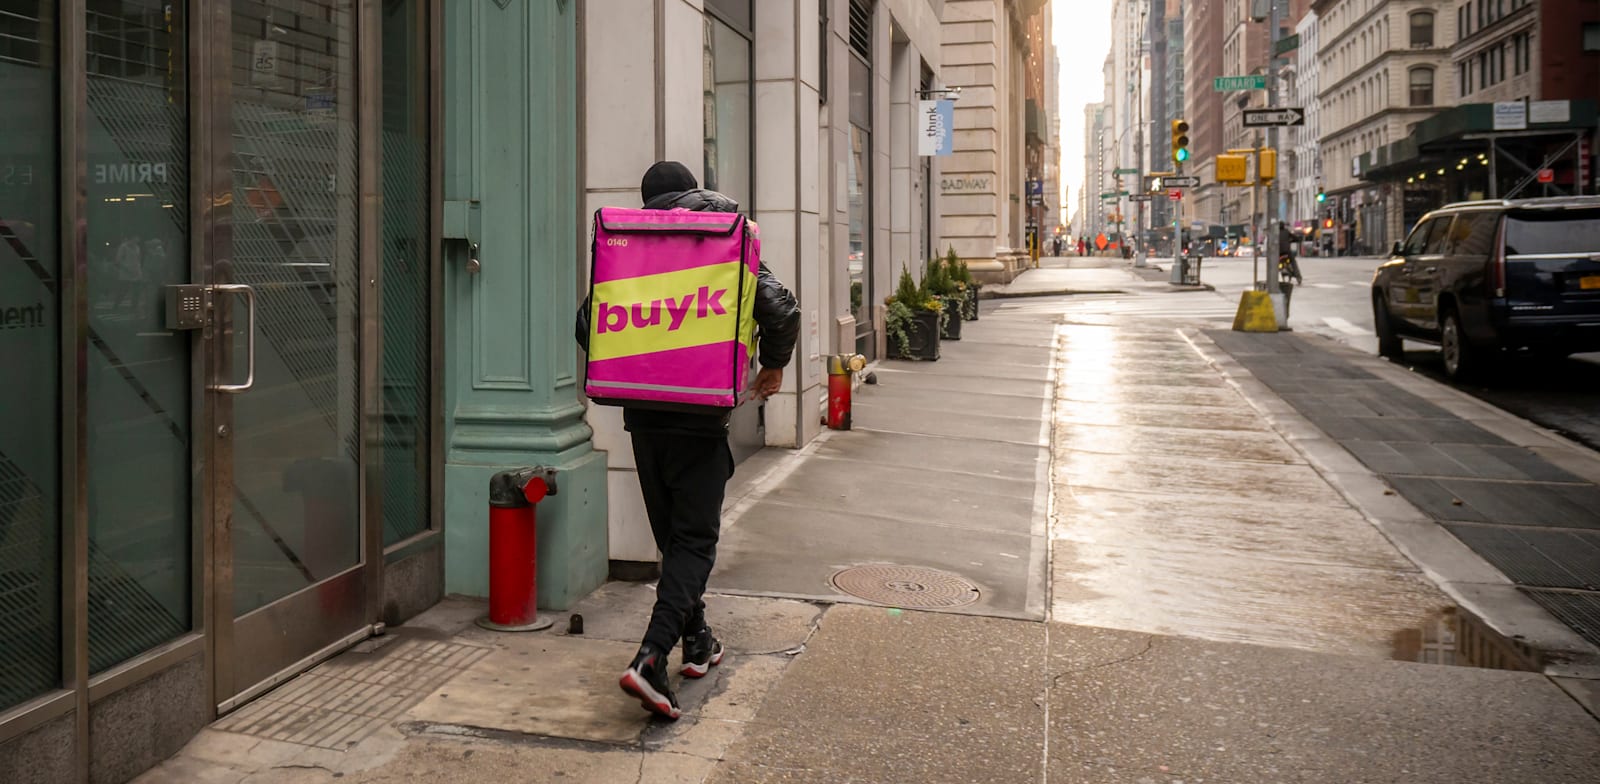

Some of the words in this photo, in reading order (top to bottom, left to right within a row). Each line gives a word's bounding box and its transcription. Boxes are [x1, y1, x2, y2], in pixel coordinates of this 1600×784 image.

[1214, 78, 1256, 90] LEONARD
[926, 107, 936, 137] think
[1251, 114, 1269, 122] ONE
[1278, 113, 1295, 121] WAY
[607, 238, 628, 247] 0140
[597, 286, 728, 334] buyk
